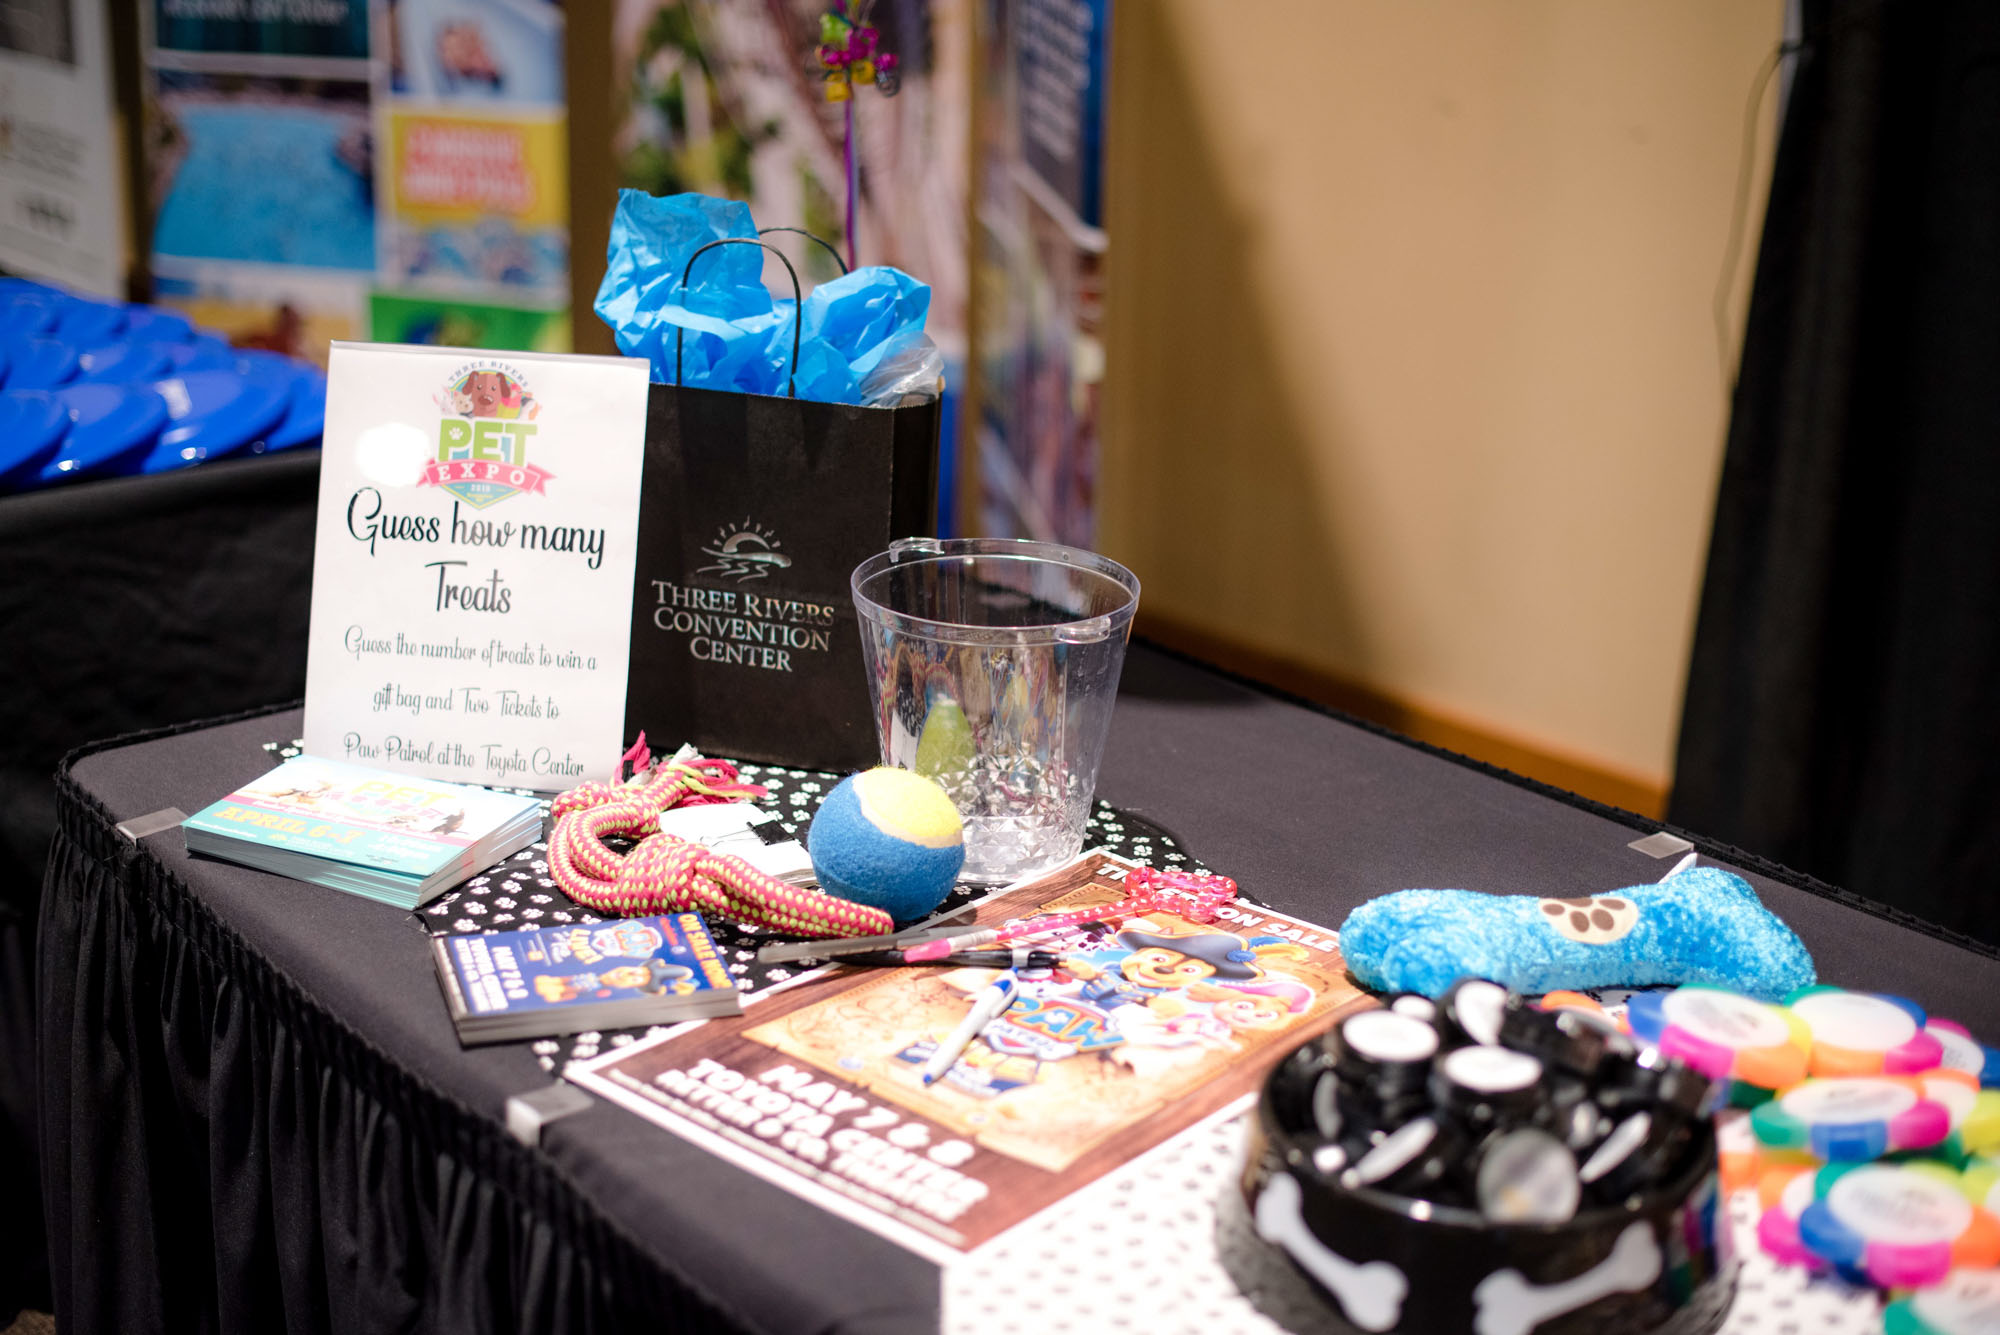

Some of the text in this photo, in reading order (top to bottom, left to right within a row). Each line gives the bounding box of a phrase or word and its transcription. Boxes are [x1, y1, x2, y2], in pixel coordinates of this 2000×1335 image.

[438, 418, 538, 466] PET
[436, 462, 526, 485] EXPO
[347, 486, 605, 570] Guess how many
[425, 560, 512, 614] Treats
[651, 579, 835, 626] THREE RIVERS
[344, 624, 598, 671] Guess the number of treats to win a
[653, 606, 832, 652] CONVENTION
[690, 636, 793, 672] CENTER
[373, 682, 560, 719] gift bag and Two Tickets to
[343, 731, 585, 778] Paw Patrol at the Toyota Center
[352, 780, 457, 807] PET
[212, 805, 308, 835] APRIL
[1215, 907, 1265, 928] ON
[1004, 994, 1127, 1051] PAW
[686, 1058, 835, 1138] TOYOTA
[829, 1128, 989, 1203] CENTER
[757, 1064, 975, 1167] MAY 7 & 8
